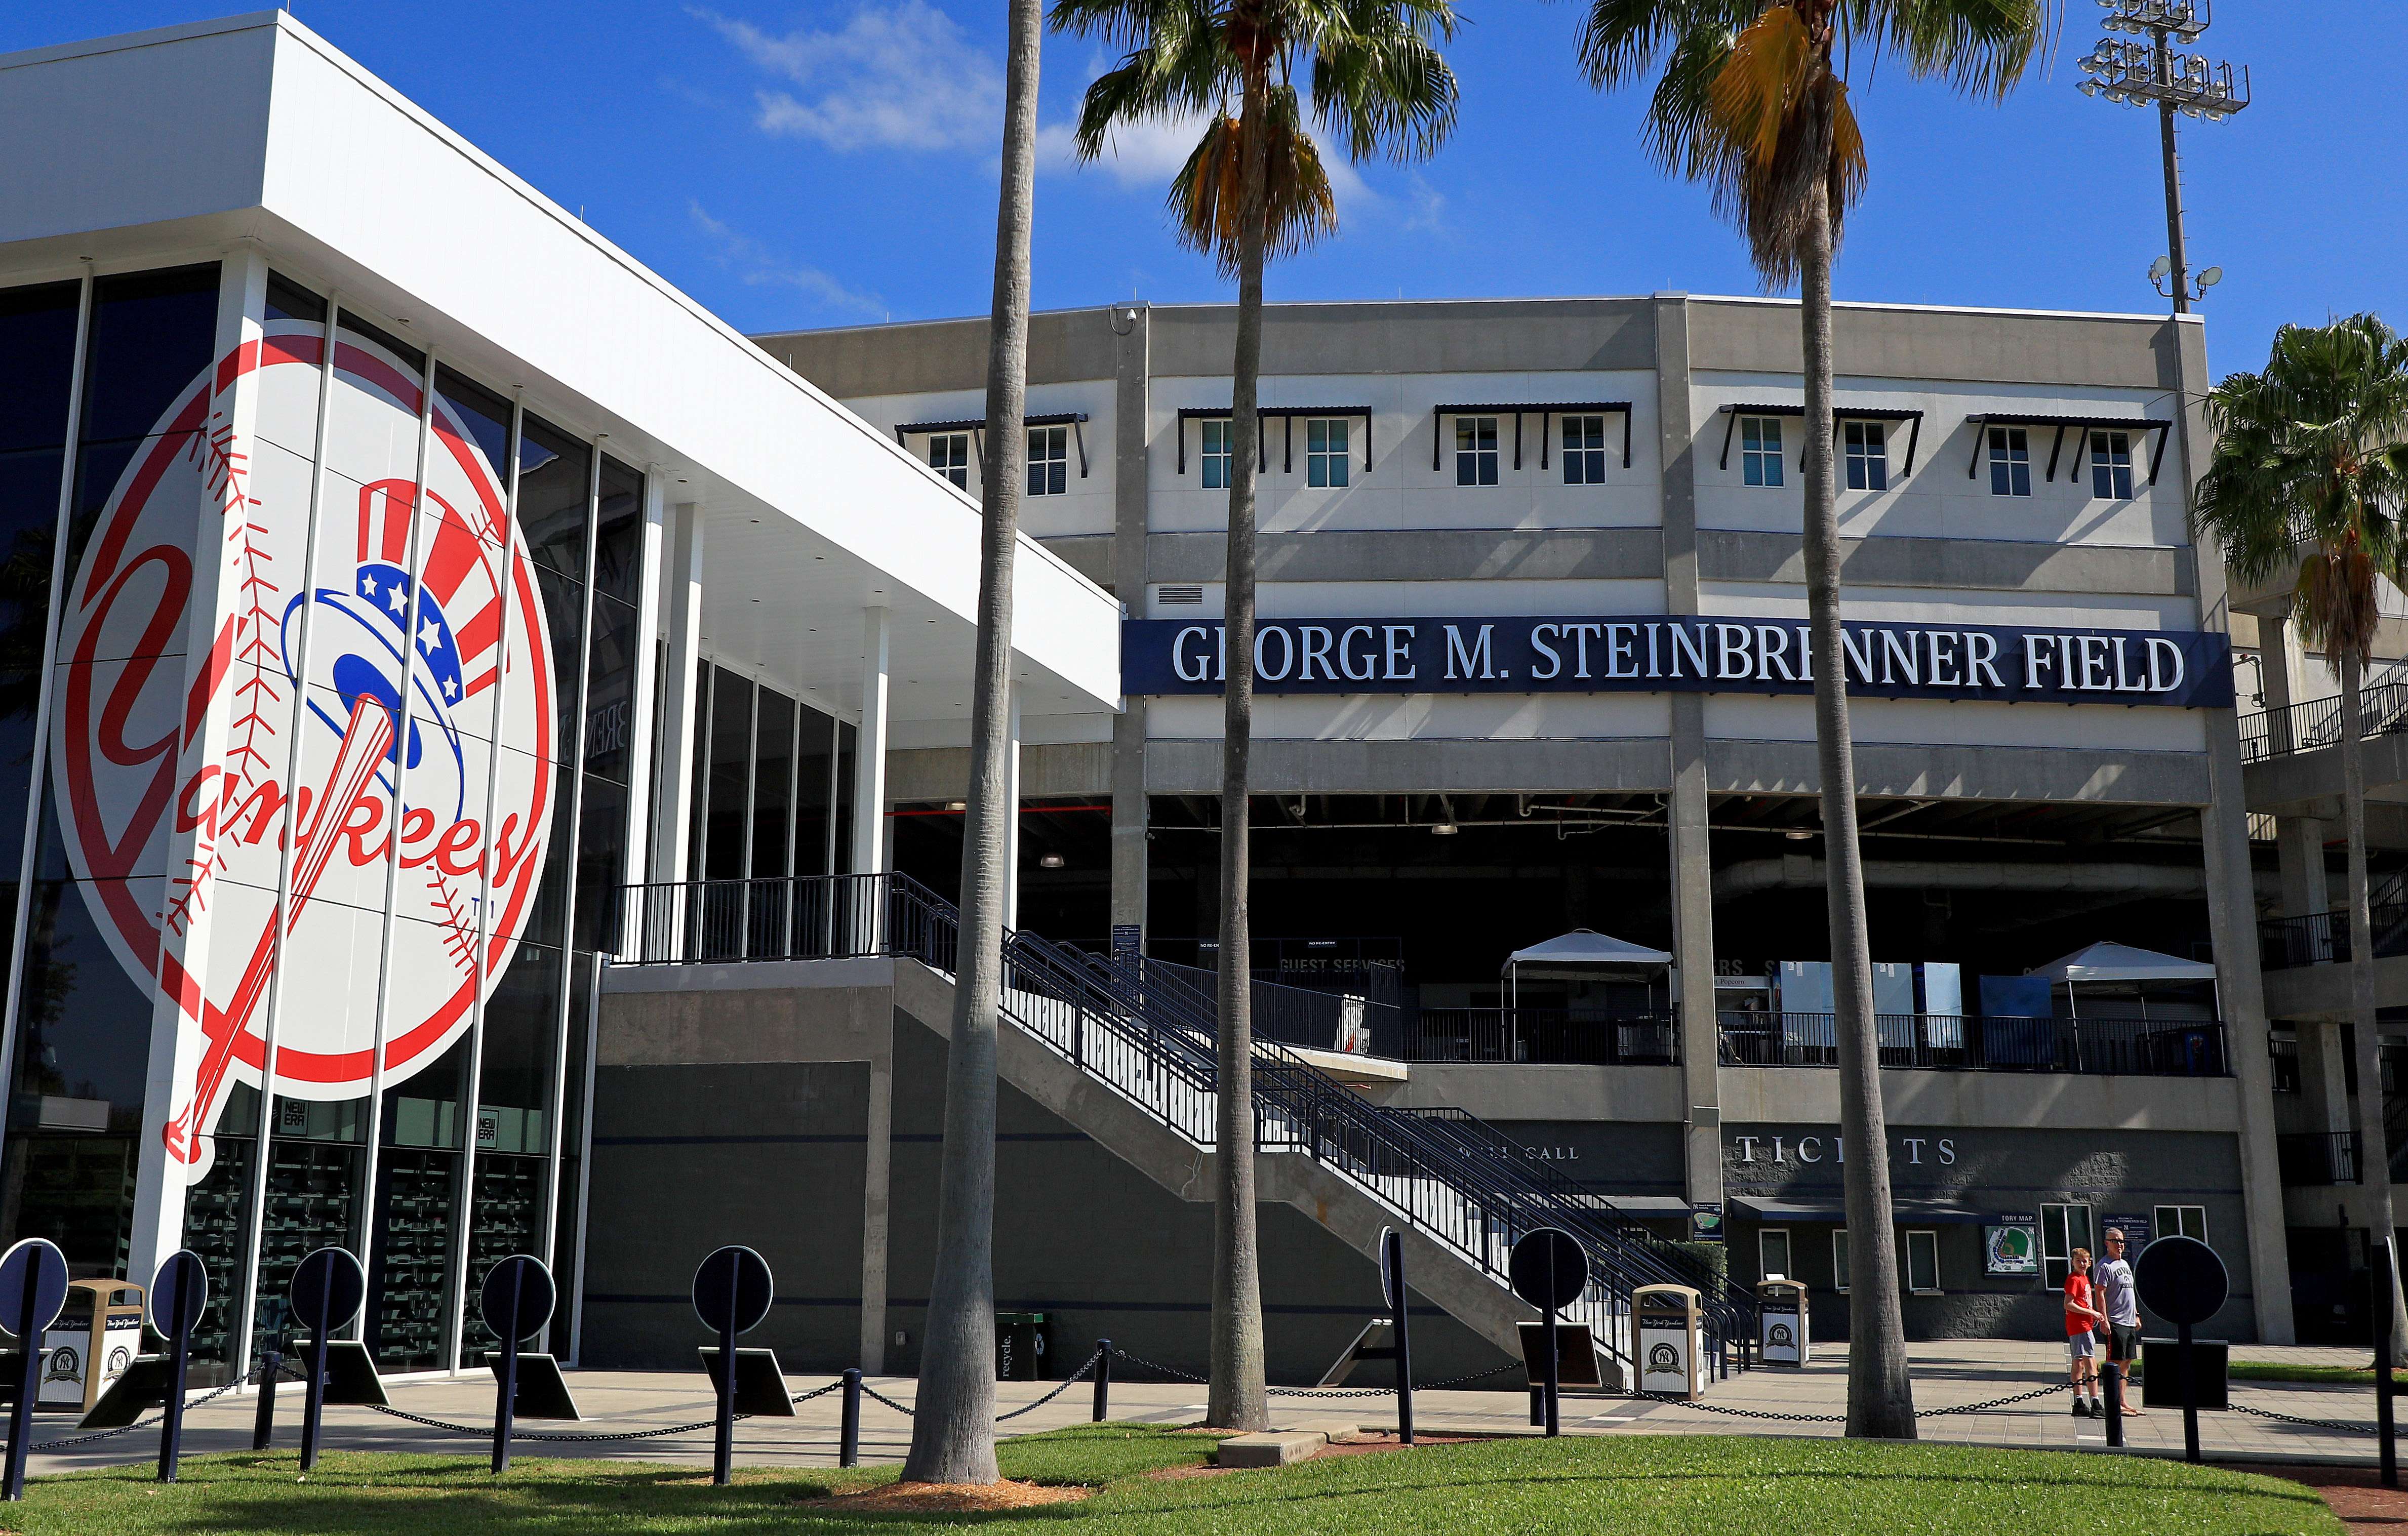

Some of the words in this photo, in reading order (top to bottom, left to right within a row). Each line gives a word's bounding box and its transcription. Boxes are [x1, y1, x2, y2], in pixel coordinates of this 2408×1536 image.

[1443, 624, 1509, 679] M.
[2022, 633, 2185, 693] FIELD
[471, 897, 494, 918] T
[1281, 959, 1327, 972] GUEST
[286, 1101, 305, 1114] NEW
[285, 1114, 304, 1126] ERA
[479, 1118, 495, 1128] NEW
[478, 1129, 495, 1140] ERA
[1525, 1147, 1579, 1159] CALL
[1736, 1136, 1955, 1165] TICTS
[1664, 1319, 1684, 1327] Yankees
[1001, 1336, 1012, 1377] recycle.
